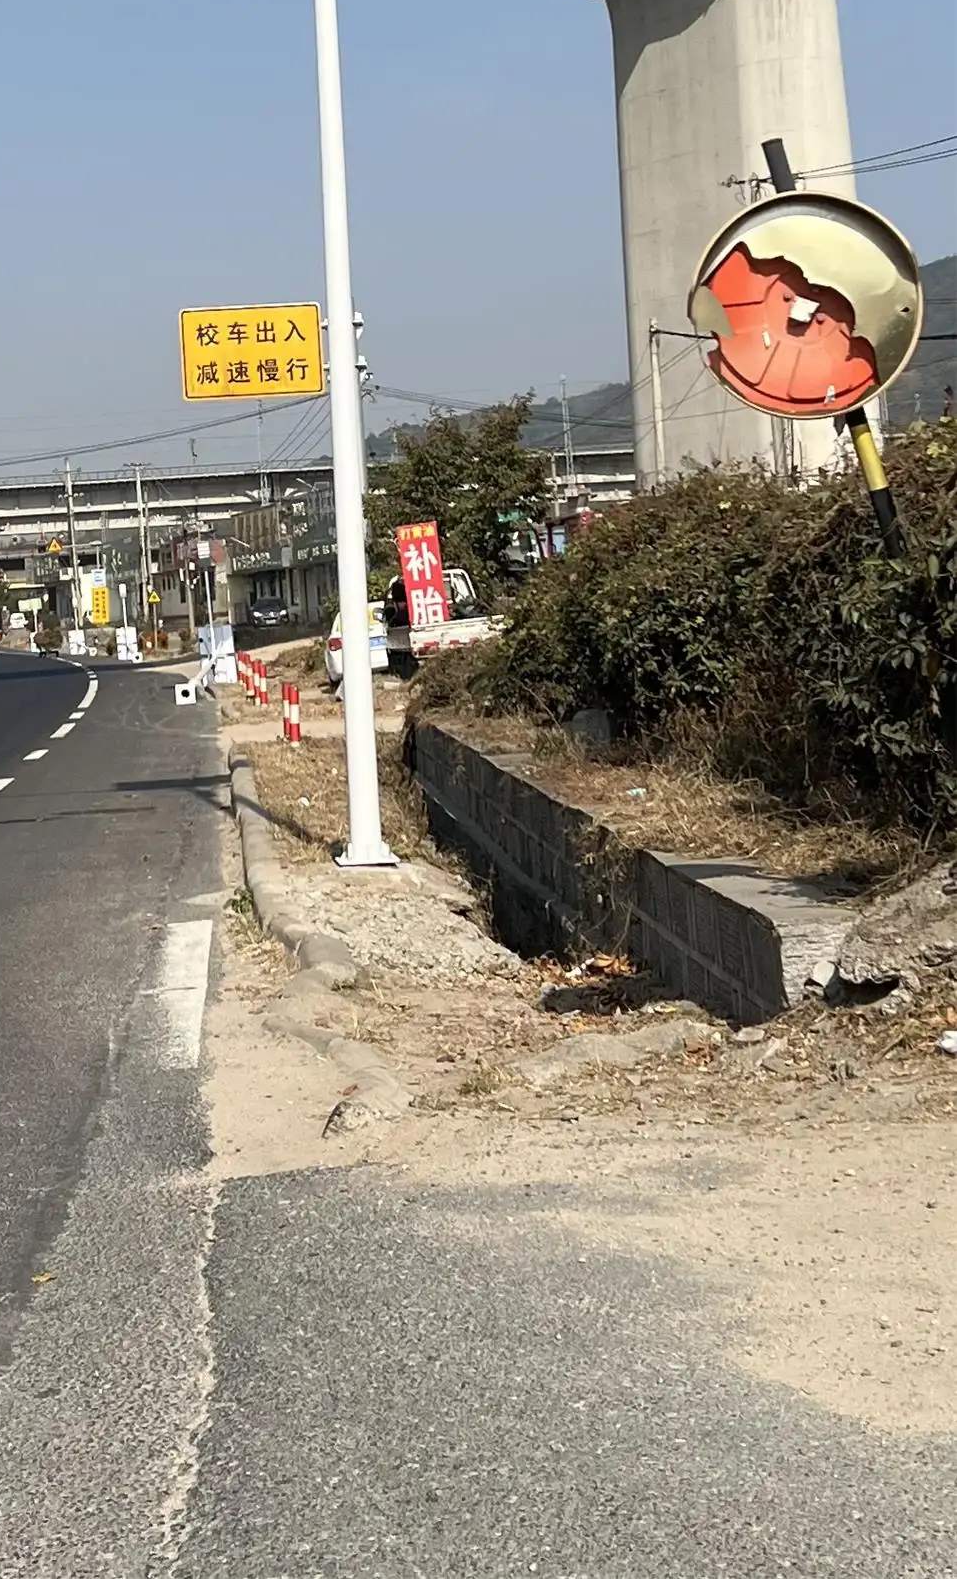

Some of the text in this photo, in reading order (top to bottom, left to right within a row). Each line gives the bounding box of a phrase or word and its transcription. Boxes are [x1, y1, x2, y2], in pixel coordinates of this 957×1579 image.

[196, 320, 306, 346] 校车出入
[196, 357, 309, 385] 减速慢行
[403, 541, 445, 625] 补胎
